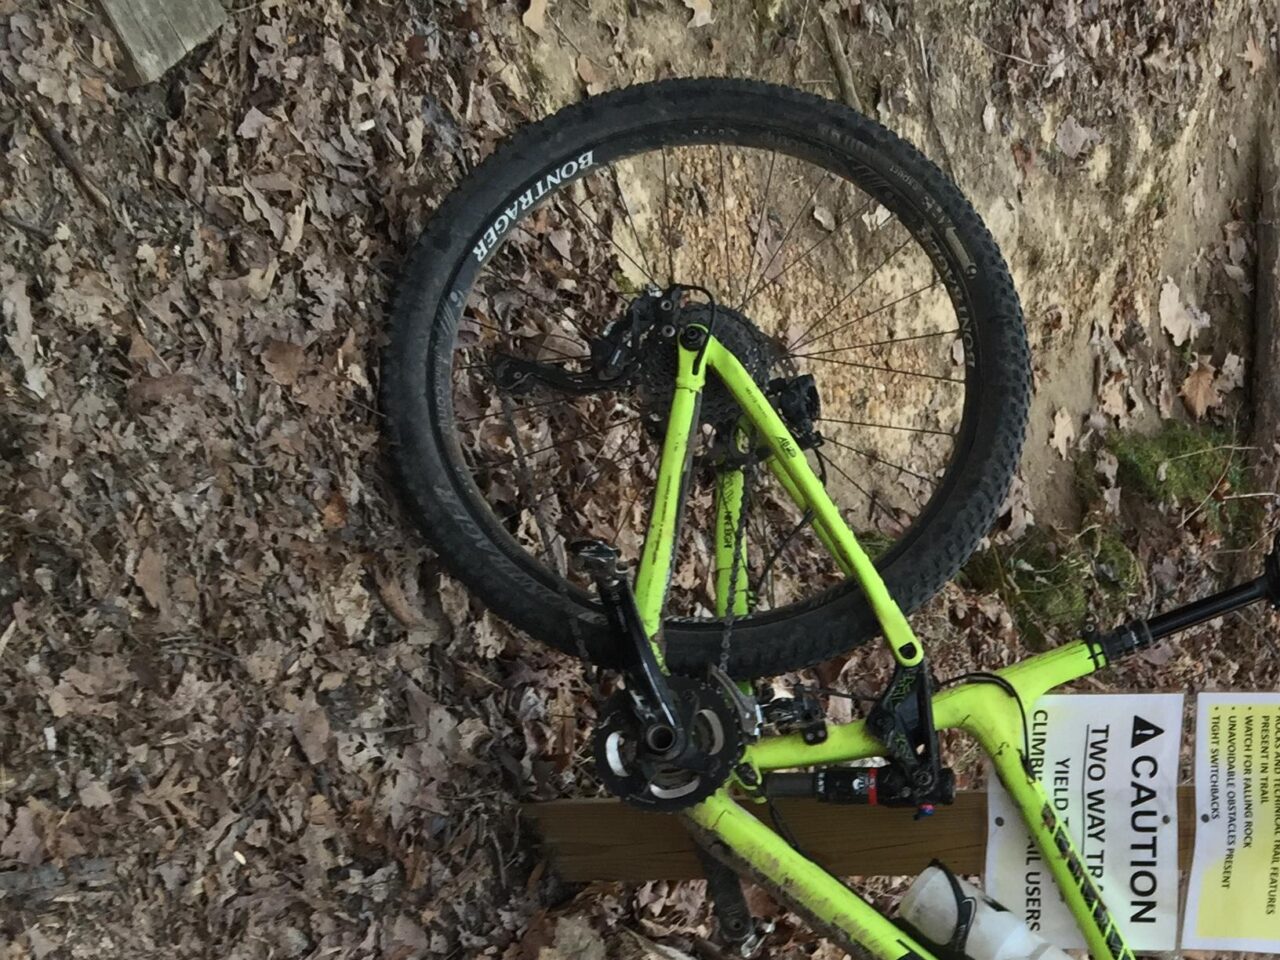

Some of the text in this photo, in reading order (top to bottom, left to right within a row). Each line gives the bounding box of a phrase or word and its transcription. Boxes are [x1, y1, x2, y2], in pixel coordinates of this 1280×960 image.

[472, 150, 594, 263] BONTRAGER
[1054, 758, 1070, 811] YIELD
[1088, 725, 1109, 781] TWO
[1211, 716, 1220, 819] TIGHT SWITCHBACKS
[1243, 716, 1253, 848] WATCH FOR FALLING ROCK
[1260, 716, 1269, 804] PRESENT IN TRAIL
[1087, 790, 1106, 842] WAY
[1129, 755, 1158, 923] CAUTION
[1221, 716, 1236, 889] UNAVOIDABLE OBSTACLES PRESENT
[1025, 871, 1041, 932] USERS
[1266, 867, 1279, 915] FEATURES
